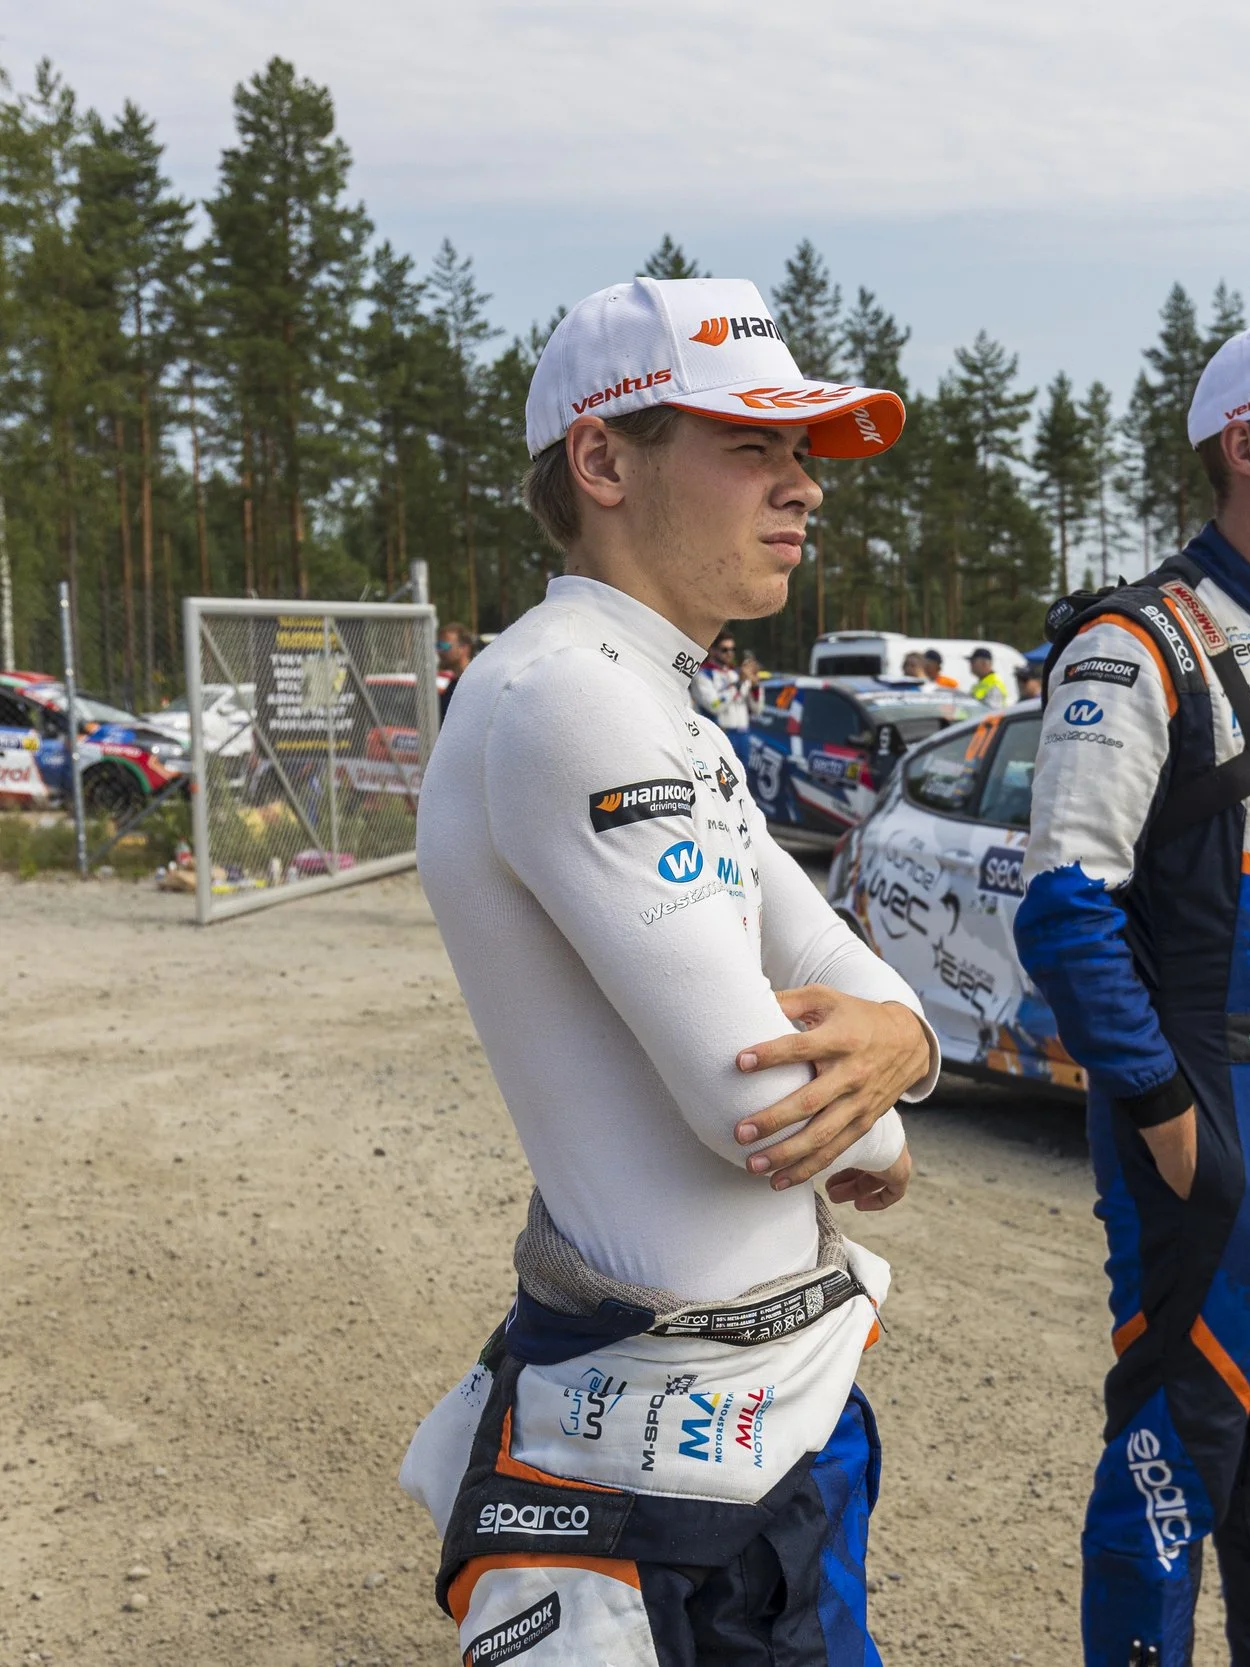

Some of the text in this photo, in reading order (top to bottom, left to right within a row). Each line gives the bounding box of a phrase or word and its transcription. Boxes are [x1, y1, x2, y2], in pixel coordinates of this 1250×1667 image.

[730, 316, 786, 343] Han
[1171, 586, 1221, 645] SIMPSON
[1140, 605, 1195, 675] sparco
[650, 801, 677, 812] driving
[669, 1315, 709, 1326] parco
[1127, 1428, 1192, 1572] sparco
[477, 1503, 590, 1536] sparco
[490, 1618, 554, 1661] driving emotion
